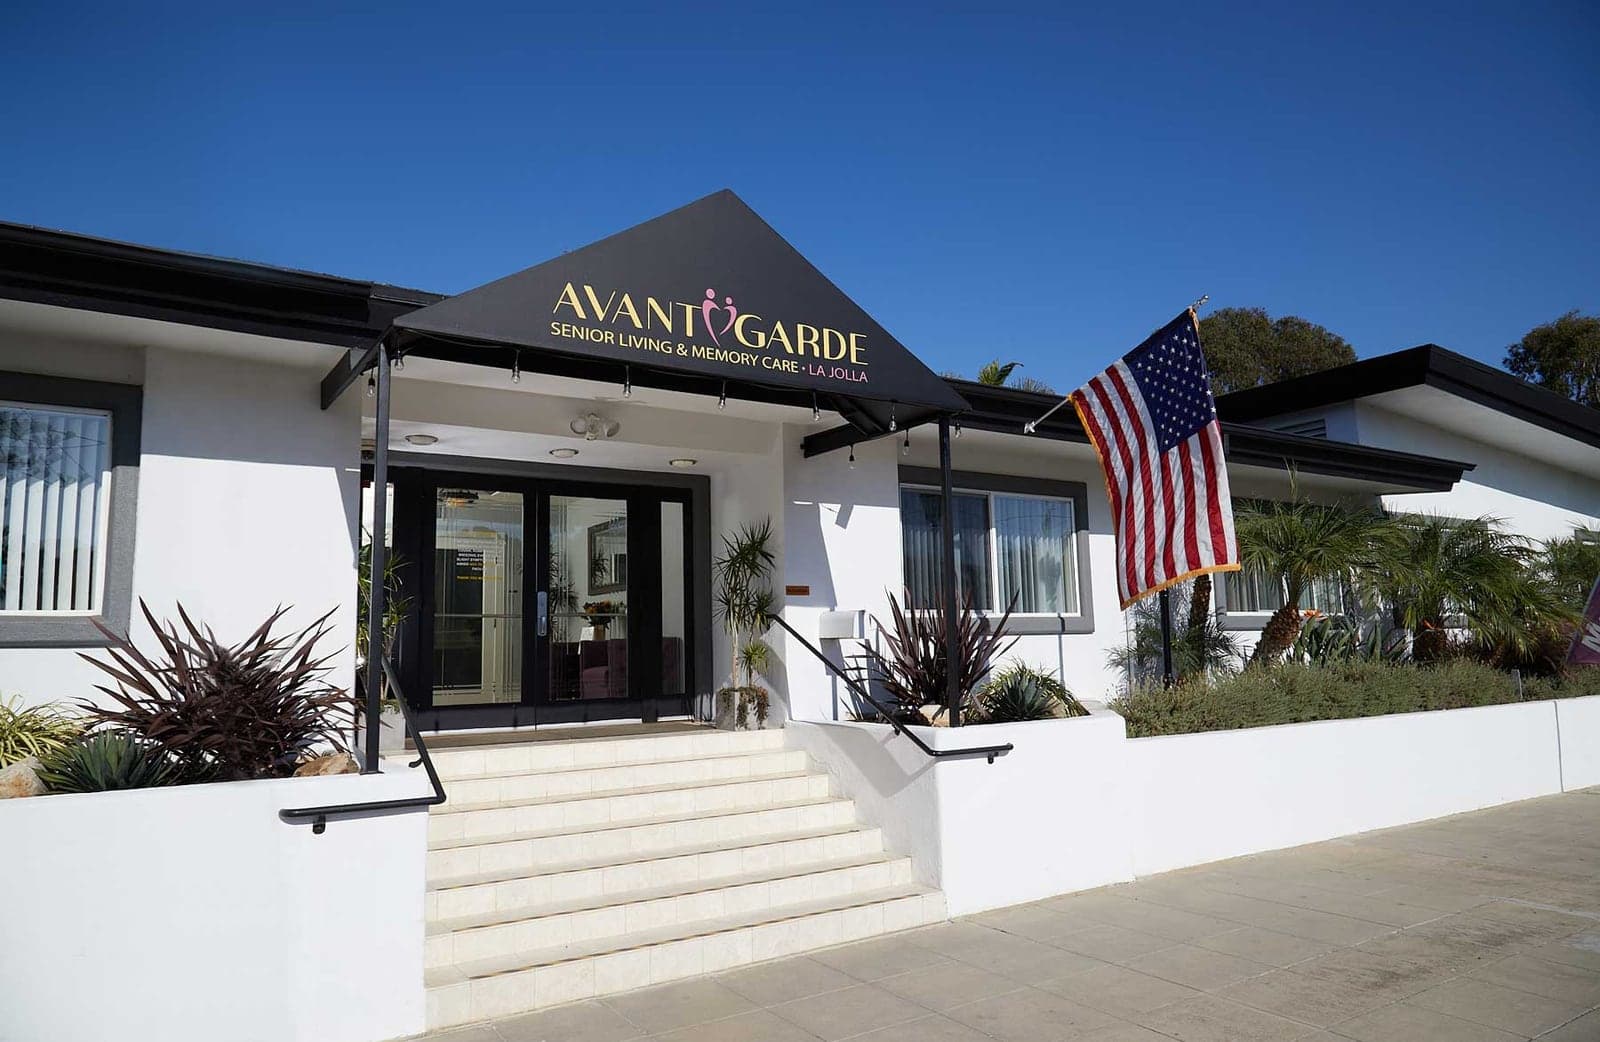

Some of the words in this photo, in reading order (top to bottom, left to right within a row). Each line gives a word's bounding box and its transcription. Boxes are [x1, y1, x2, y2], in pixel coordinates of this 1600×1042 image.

[550, 321, 615, 345] SENIOR
[619, 332, 673, 354] LIVING
[676, 343, 689, 357] &
[691, 344, 759, 367] MEMORY
[761, 356, 799, 374] CARE
[808, 363, 826, 377] LA
[828, 367, 869, 383] JOLLA
[553, 282, 702, 338] AVANT
[733, 314, 869, 366] GARDE
